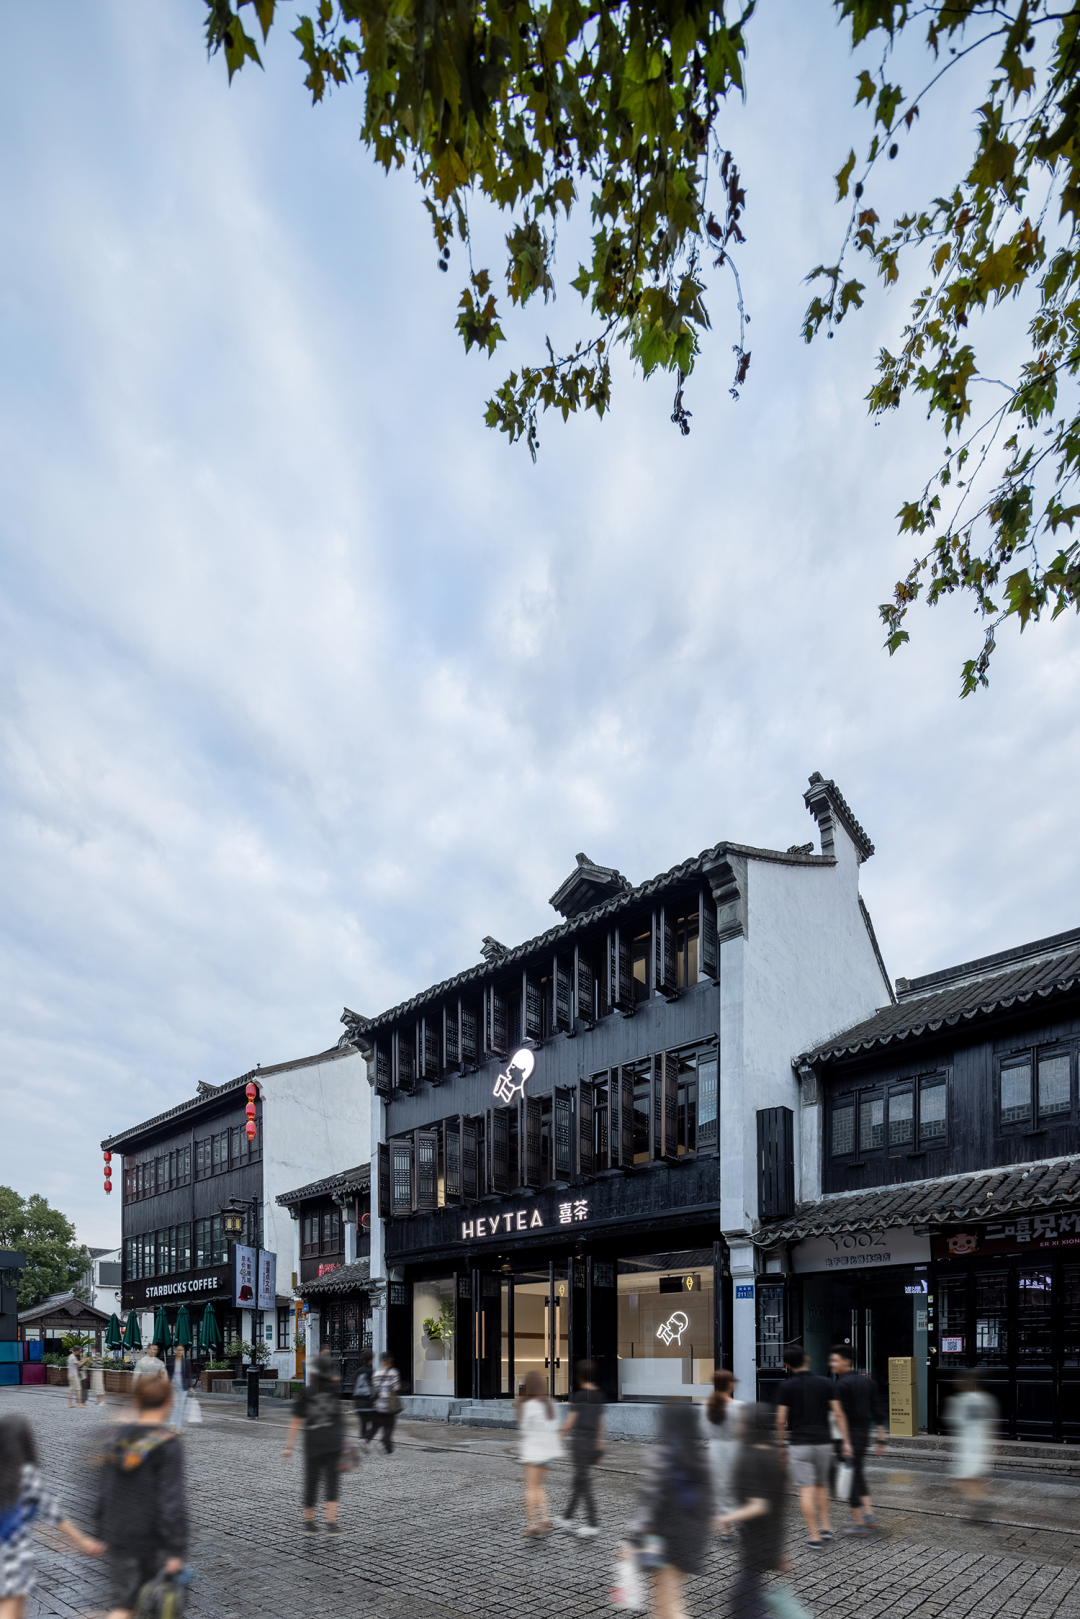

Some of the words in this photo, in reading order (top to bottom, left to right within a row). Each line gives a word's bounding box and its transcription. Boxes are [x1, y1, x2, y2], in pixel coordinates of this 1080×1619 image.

[559, 1200, 588, 1224] 喜茶
[462, 1208, 543, 1239] HEYTEA
[828, 1231, 886, 1251] YOOZ
[145, 1281, 187, 1298] STARBUCKS
[188, 1277, 218, 1292] COFFEE
